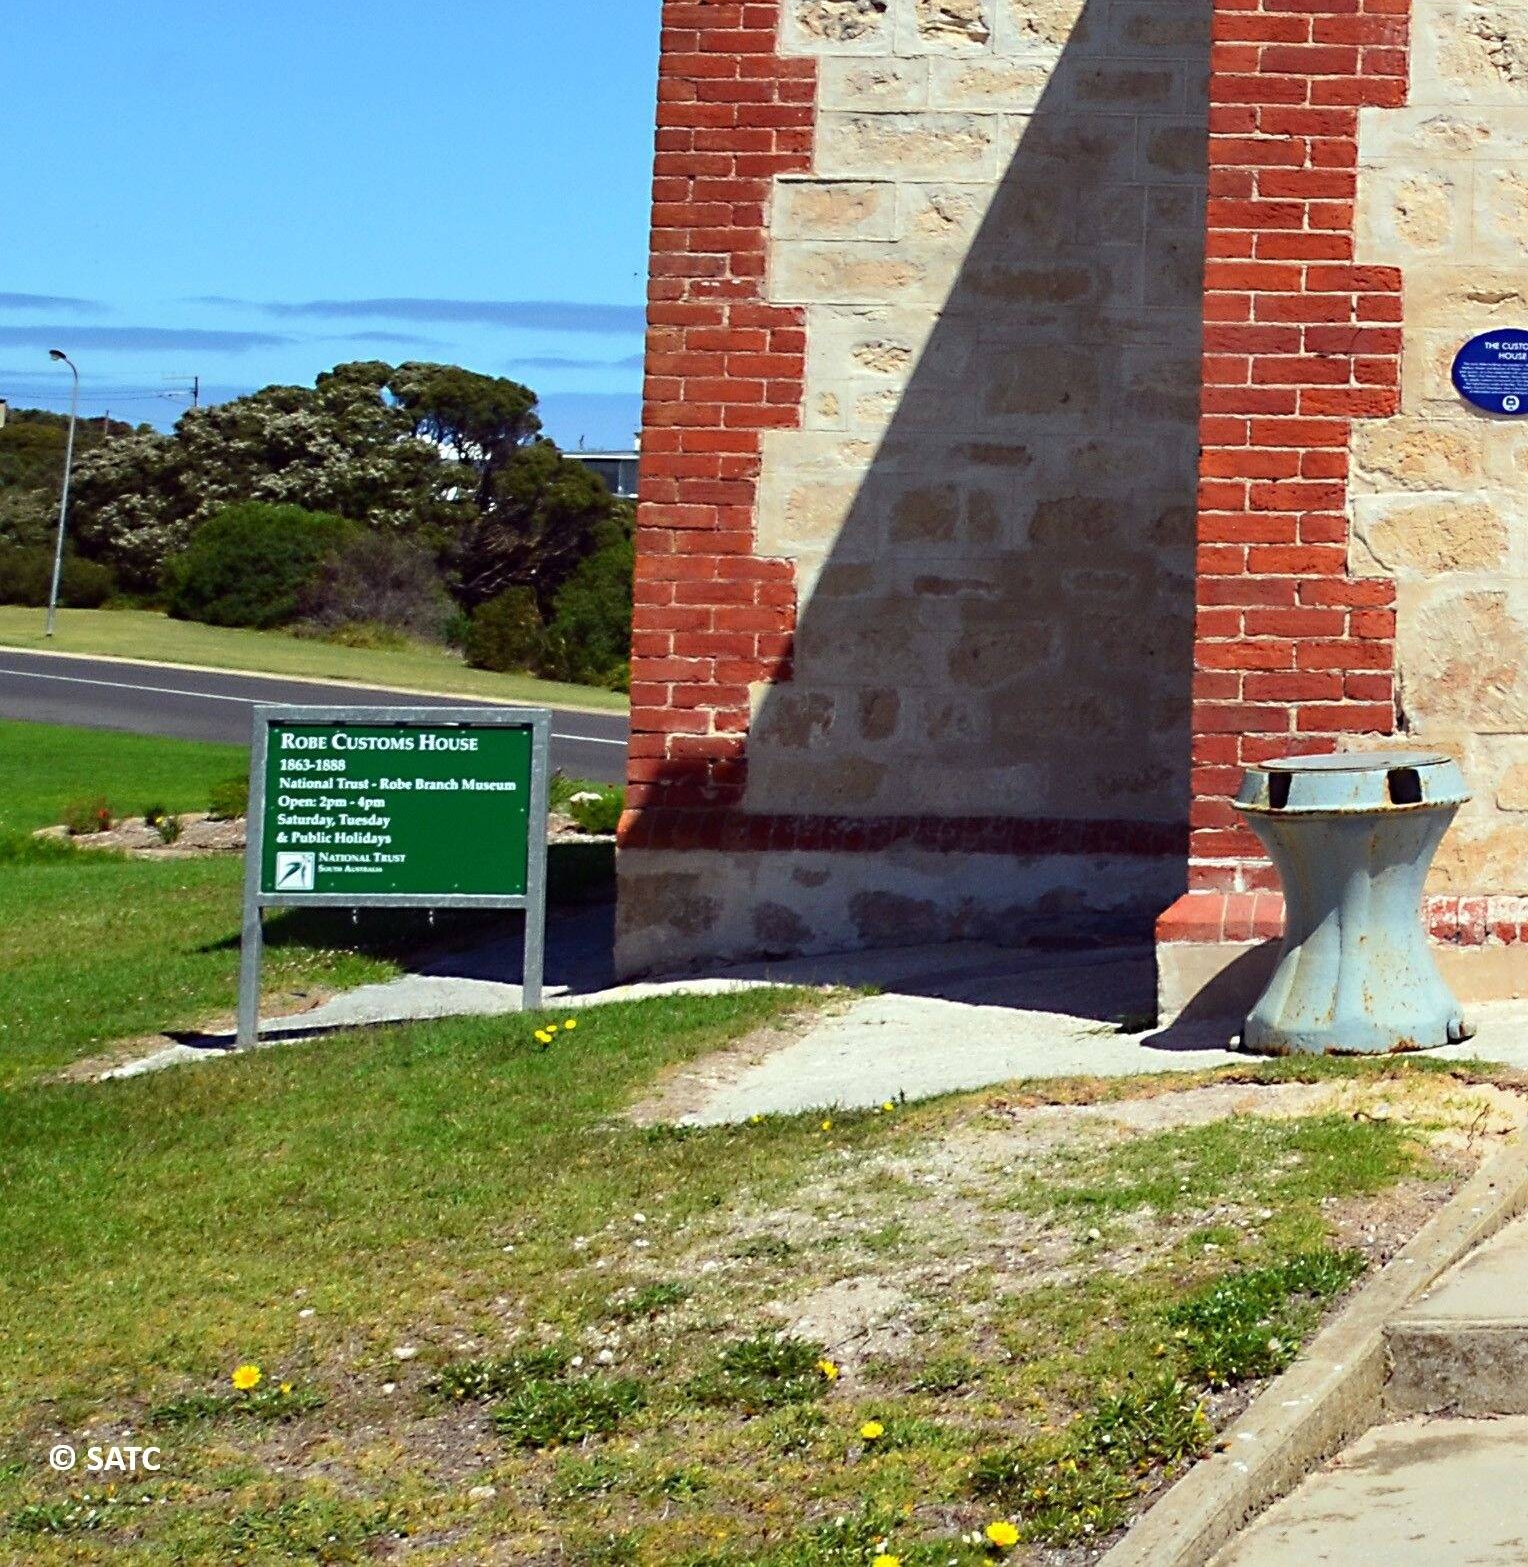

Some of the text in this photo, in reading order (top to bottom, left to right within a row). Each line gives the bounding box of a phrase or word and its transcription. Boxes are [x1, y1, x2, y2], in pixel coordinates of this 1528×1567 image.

[1484, 341, 1500, 350] THE
[1498, 352, 1528, 361] HOUSE
[281, 732, 479, 751] ROBE CUSTOMS HOUSE
[279, 758, 346, 772] 1863-1888
[279, 777, 333, 789] National
[336, 778, 369, 790] Trust
[379, 778, 413, 790] Robe
[415, 778, 459, 791] Branch
[461, 779, 517, 791] Museum
[277, 795, 317, 810] Open:
[319, 796, 347, 810] 2pm
[357, 796, 386, 811] 4pm
[277, 813, 391, 829] Saturday, Tuesday
[276, 832, 392, 847] & Public Holidays
[318, 852, 406, 863] NATIONAL TRUST
